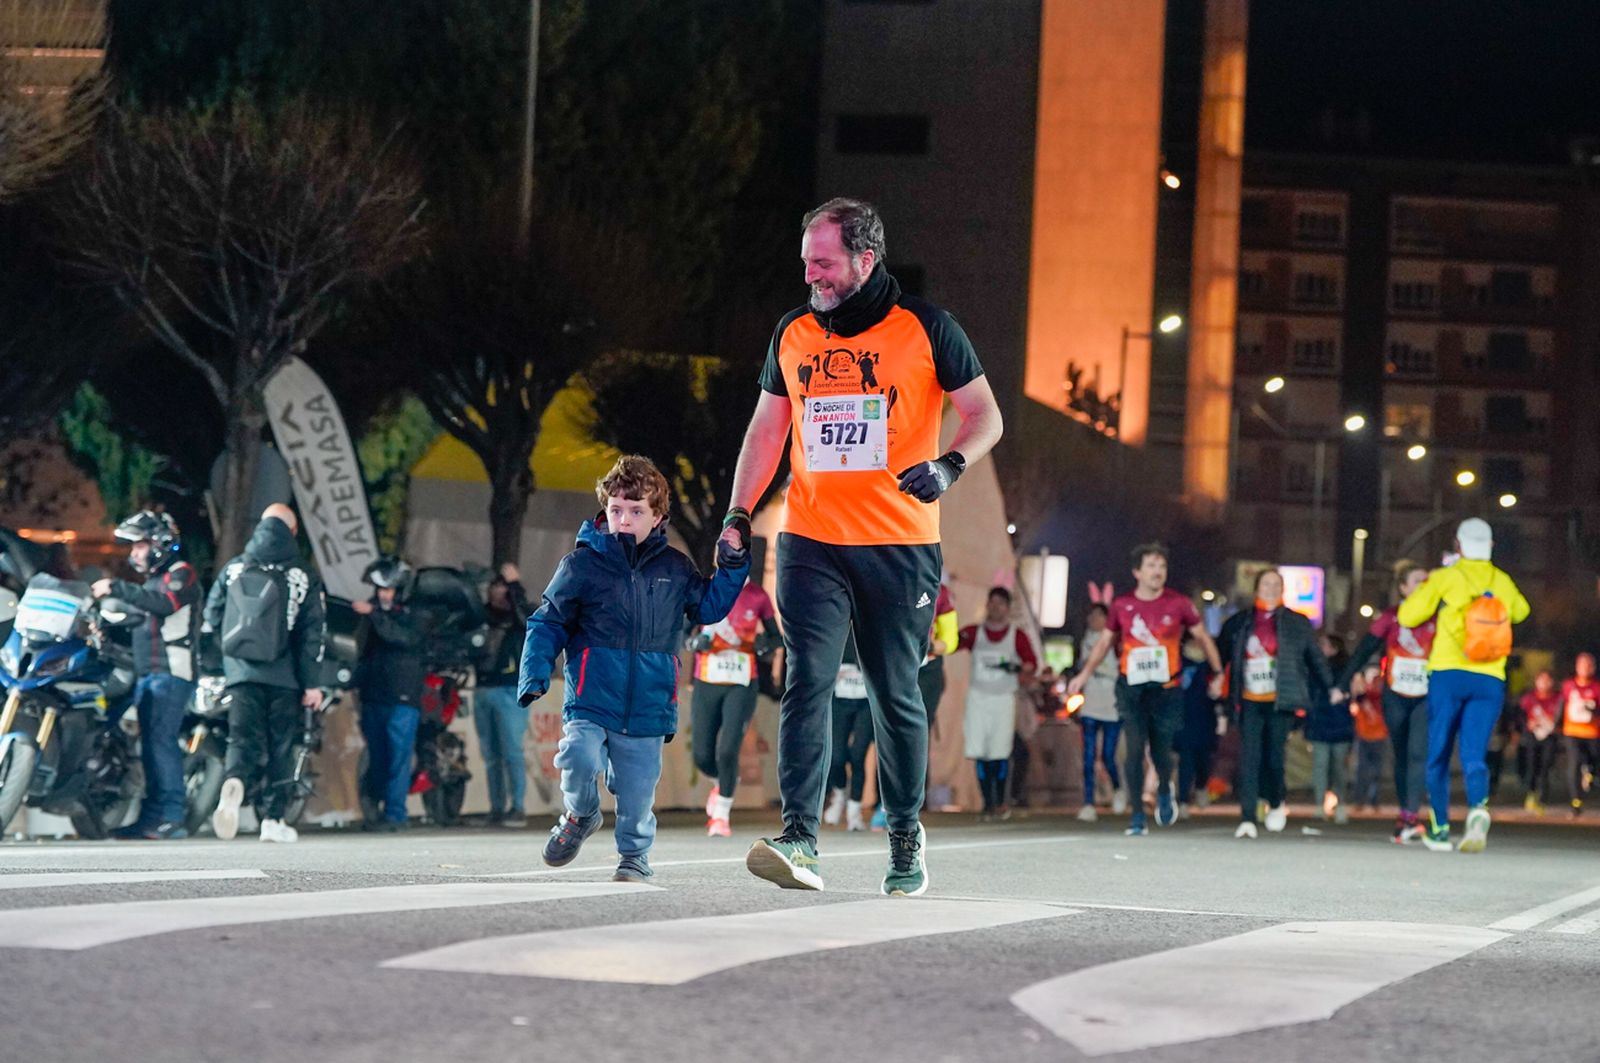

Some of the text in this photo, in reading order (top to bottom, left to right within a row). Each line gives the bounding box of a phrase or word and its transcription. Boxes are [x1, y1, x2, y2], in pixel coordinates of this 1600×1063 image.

[822, 404, 844, 413] NOCHE
[846, 403, 856, 411] DE
[813, 414, 828, 423] SAN
[821, 423, 868, 445] 5727
[304, 394, 371, 563] JAPEMASA
